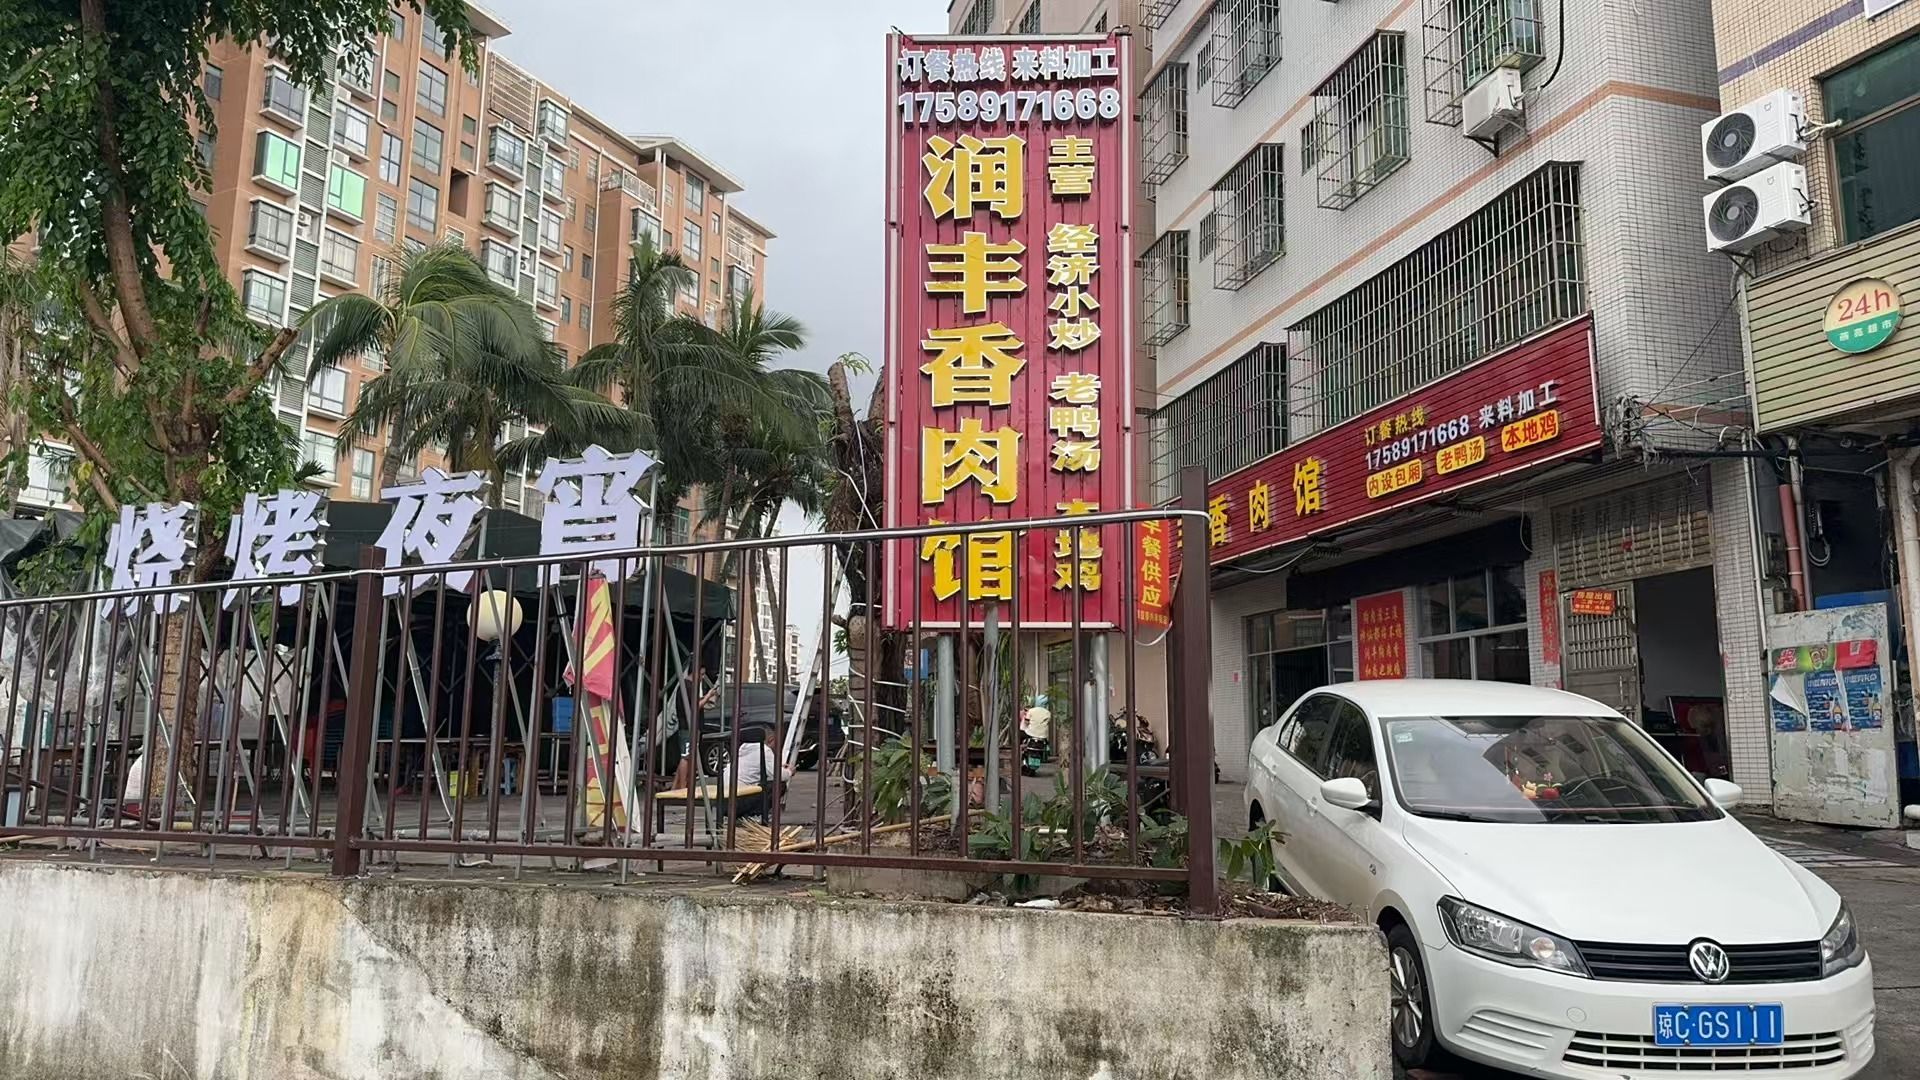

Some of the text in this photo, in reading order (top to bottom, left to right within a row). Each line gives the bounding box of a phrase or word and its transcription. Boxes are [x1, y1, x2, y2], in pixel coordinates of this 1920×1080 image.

[898, 45, 1118, 83] 订餐热线 来料加工
[899, 88, 1120, 123] 17589171668
[1047, 223, 1101, 350] 经济小炒
[1838, 289, 1890, 322] 24h
[919, 134, 1028, 601] 润丰香肉馆
[1048, 372, 1101, 472] 老鸭汤
[1365, 379, 1557, 470] 17589171668 来料加工
[1365, 405, 1425, 446] 订餐热线
[1440, 439, 1484, 471] 老鸭汤
[1505, 411, 1557, 449] 本地鸡
[1177, 456, 1321, 550] 香肉馆
